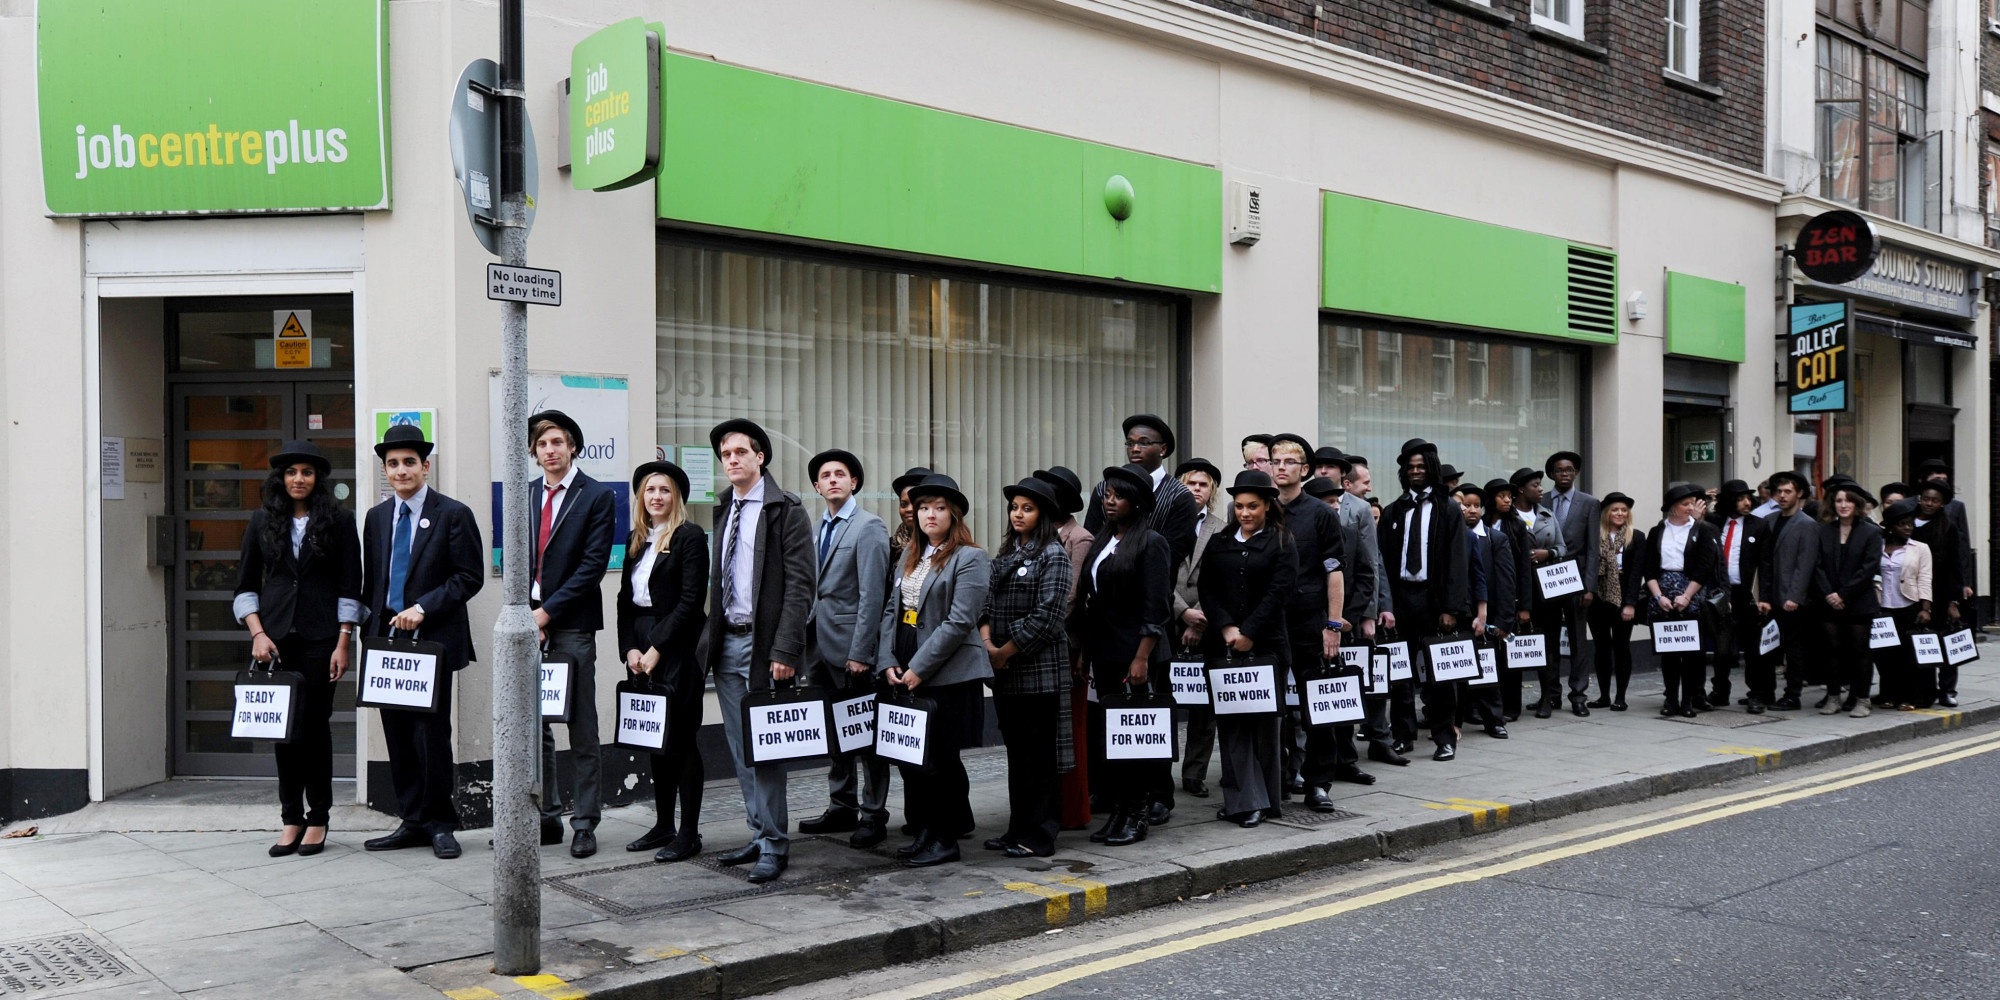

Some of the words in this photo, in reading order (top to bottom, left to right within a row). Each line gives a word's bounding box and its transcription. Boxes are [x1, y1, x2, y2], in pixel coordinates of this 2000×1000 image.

[586, 62, 608, 103] job
[585, 91, 630, 128] centre
[75, 119, 348, 180] jobcentreplus
[586, 127, 615, 165] plus
[1810, 225, 1856, 246] ZEN
[1805, 246, 1857, 266] BAR
[1873, 248, 1921, 285] SOUNDS
[1924, 260, 1964, 296] STUDIO
[493, 270, 509, 281] No
[513, 272, 554, 288] loading
[493, 284, 504, 294] at
[508, 287, 528, 298] any
[532, 288, 556, 299] time
[280, 341, 306, 349] Caution
[1791, 323, 1845, 356] ALLEY
[1797, 345, 1845, 389] CAT
[1701, 443, 1714, 451] exit
[1752, 436, 1762, 469] 3
[1546, 565, 1568, 578] READY
[1544, 580, 1557, 590] FOR
[1558, 576, 1578, 587] WORK
[1664, 624, 1688, 633] READY
[1515, 639, 1537, 648] READY
[1659, 636, 1673, 644] FOR
[1871, 633, 1879, 641] OR
[1951, 634, 1967, 644] READY
[1390, 646, 1401, 656] ADY
[1440, 645, 1464, 657] READY
[1511, 652, 1524, 660] FOR
[1524, 650, 1543, 659] WORK
[1960, 644, 1974, 653] WORK
[1341, 651, 1357, 661] ADY
[382, 656, 421, 672] READY
[1392, 660, 1408, 670] WORK
[1436, 662, 1452, 671] FOR
[1452, 658, 1474, 669] WORK
[1482, 666, 1494, 674] ORK
[370, 676, 392, 689] FOR
[394, 678, 428, 692] WORK
[1224, 672, 1260, 685] READY
[1373, 674, 1384, 682] ORK
[1172, 683, 1184, 692] OR
[1186, 683, 1208, 692] WOR
[1318, 682, 1348, 695] READY
[245, 691, 275, 704] READY
[541, 690, 560, 700] ORK
[1218, 691, 1237, 702] FOR
[1238, 689, 1271, 700] WORK
[630, 698, 656, 713] READY
[847, 700, 874, 717] READ
[1313, 702, 1330, 712] FOR
[1332, 698, 1358, 710] WORK
[238, 712, 250, 723] FOR
[254, 712, 282, 724] WORK
[766, 708, 808, 724] READY
[888, 710, 916, 728] READY
[1120, 714, 1157, 726] READY
[623, 718, 638, 731] FOR
[639, 720, 661, 733] WORK
[842, 723, 863, 738] FOR
[758, 732, 782, 746] FOR
[784, 728, 821, 742] WORK
[881, 730, 896, 744] FOR
[898, 733, 921, 750] WORK
[1112, 734, 1132, 746] FOR
[1134, 733, 1166, 745] WORK
